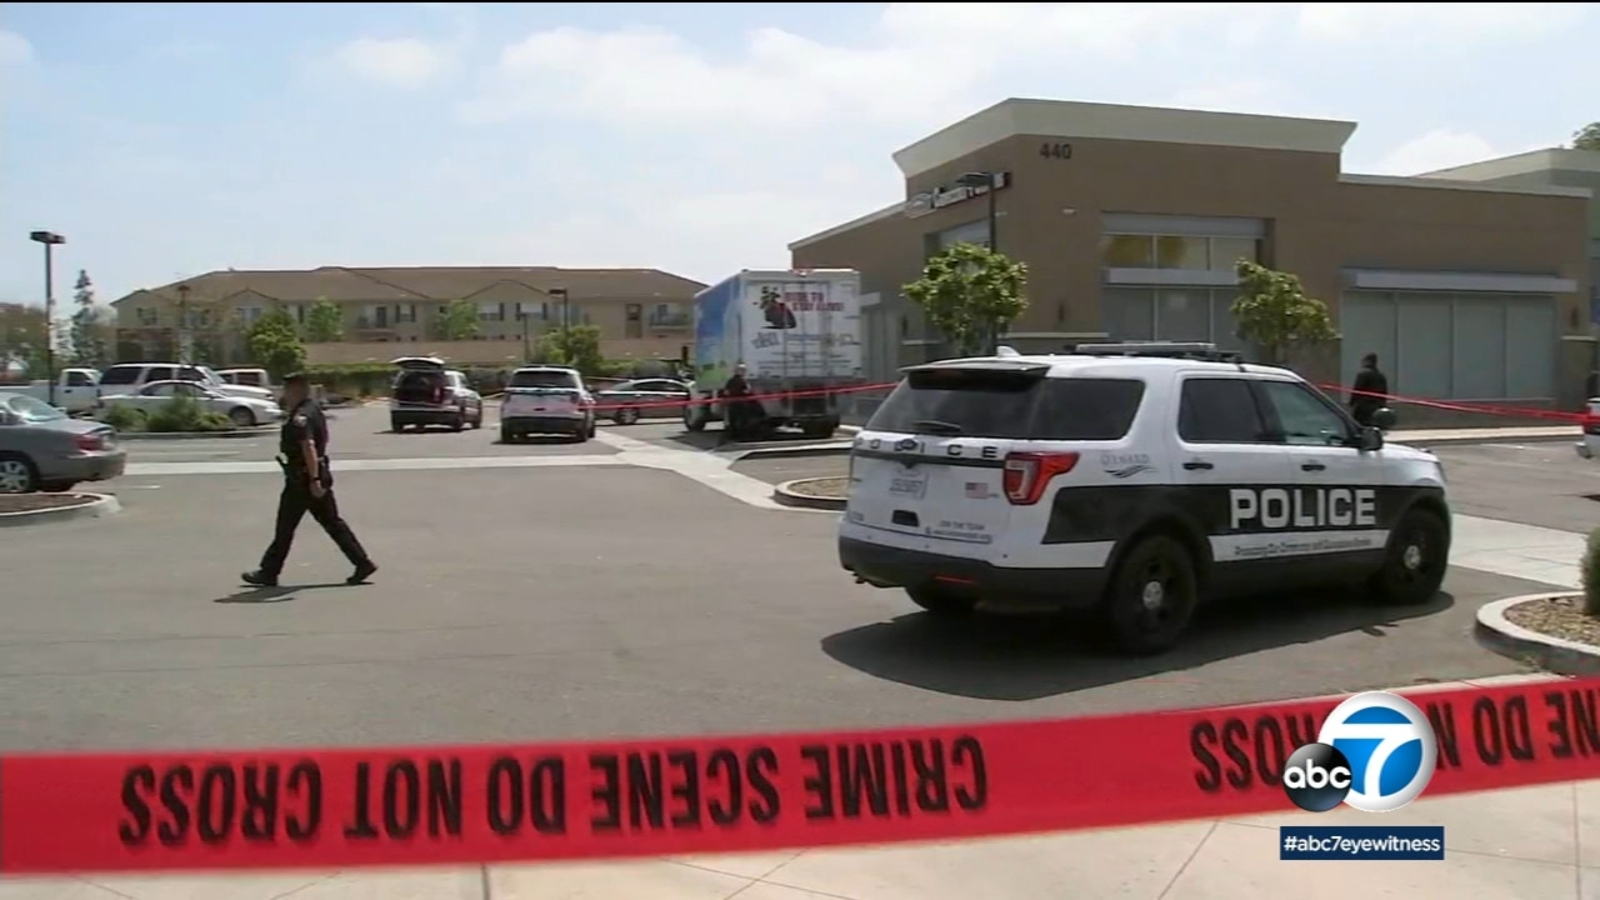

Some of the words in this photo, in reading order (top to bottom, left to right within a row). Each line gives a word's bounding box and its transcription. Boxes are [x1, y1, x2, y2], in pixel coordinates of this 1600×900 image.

[1039, 143, 1073, 160] 440
[854, 437, 998, 459] POLICE
[1229, 488, 1376, 529] POLICE
[1473, 695, 1535, 766] DO
[119, 759, 323, 847] CROSS
[344, 758, 463, 841] NOT
[487, 757, 566, 835] DO
[590, 747, 780, 831] SCENE
[800, 735, 987, 819] CRIME
